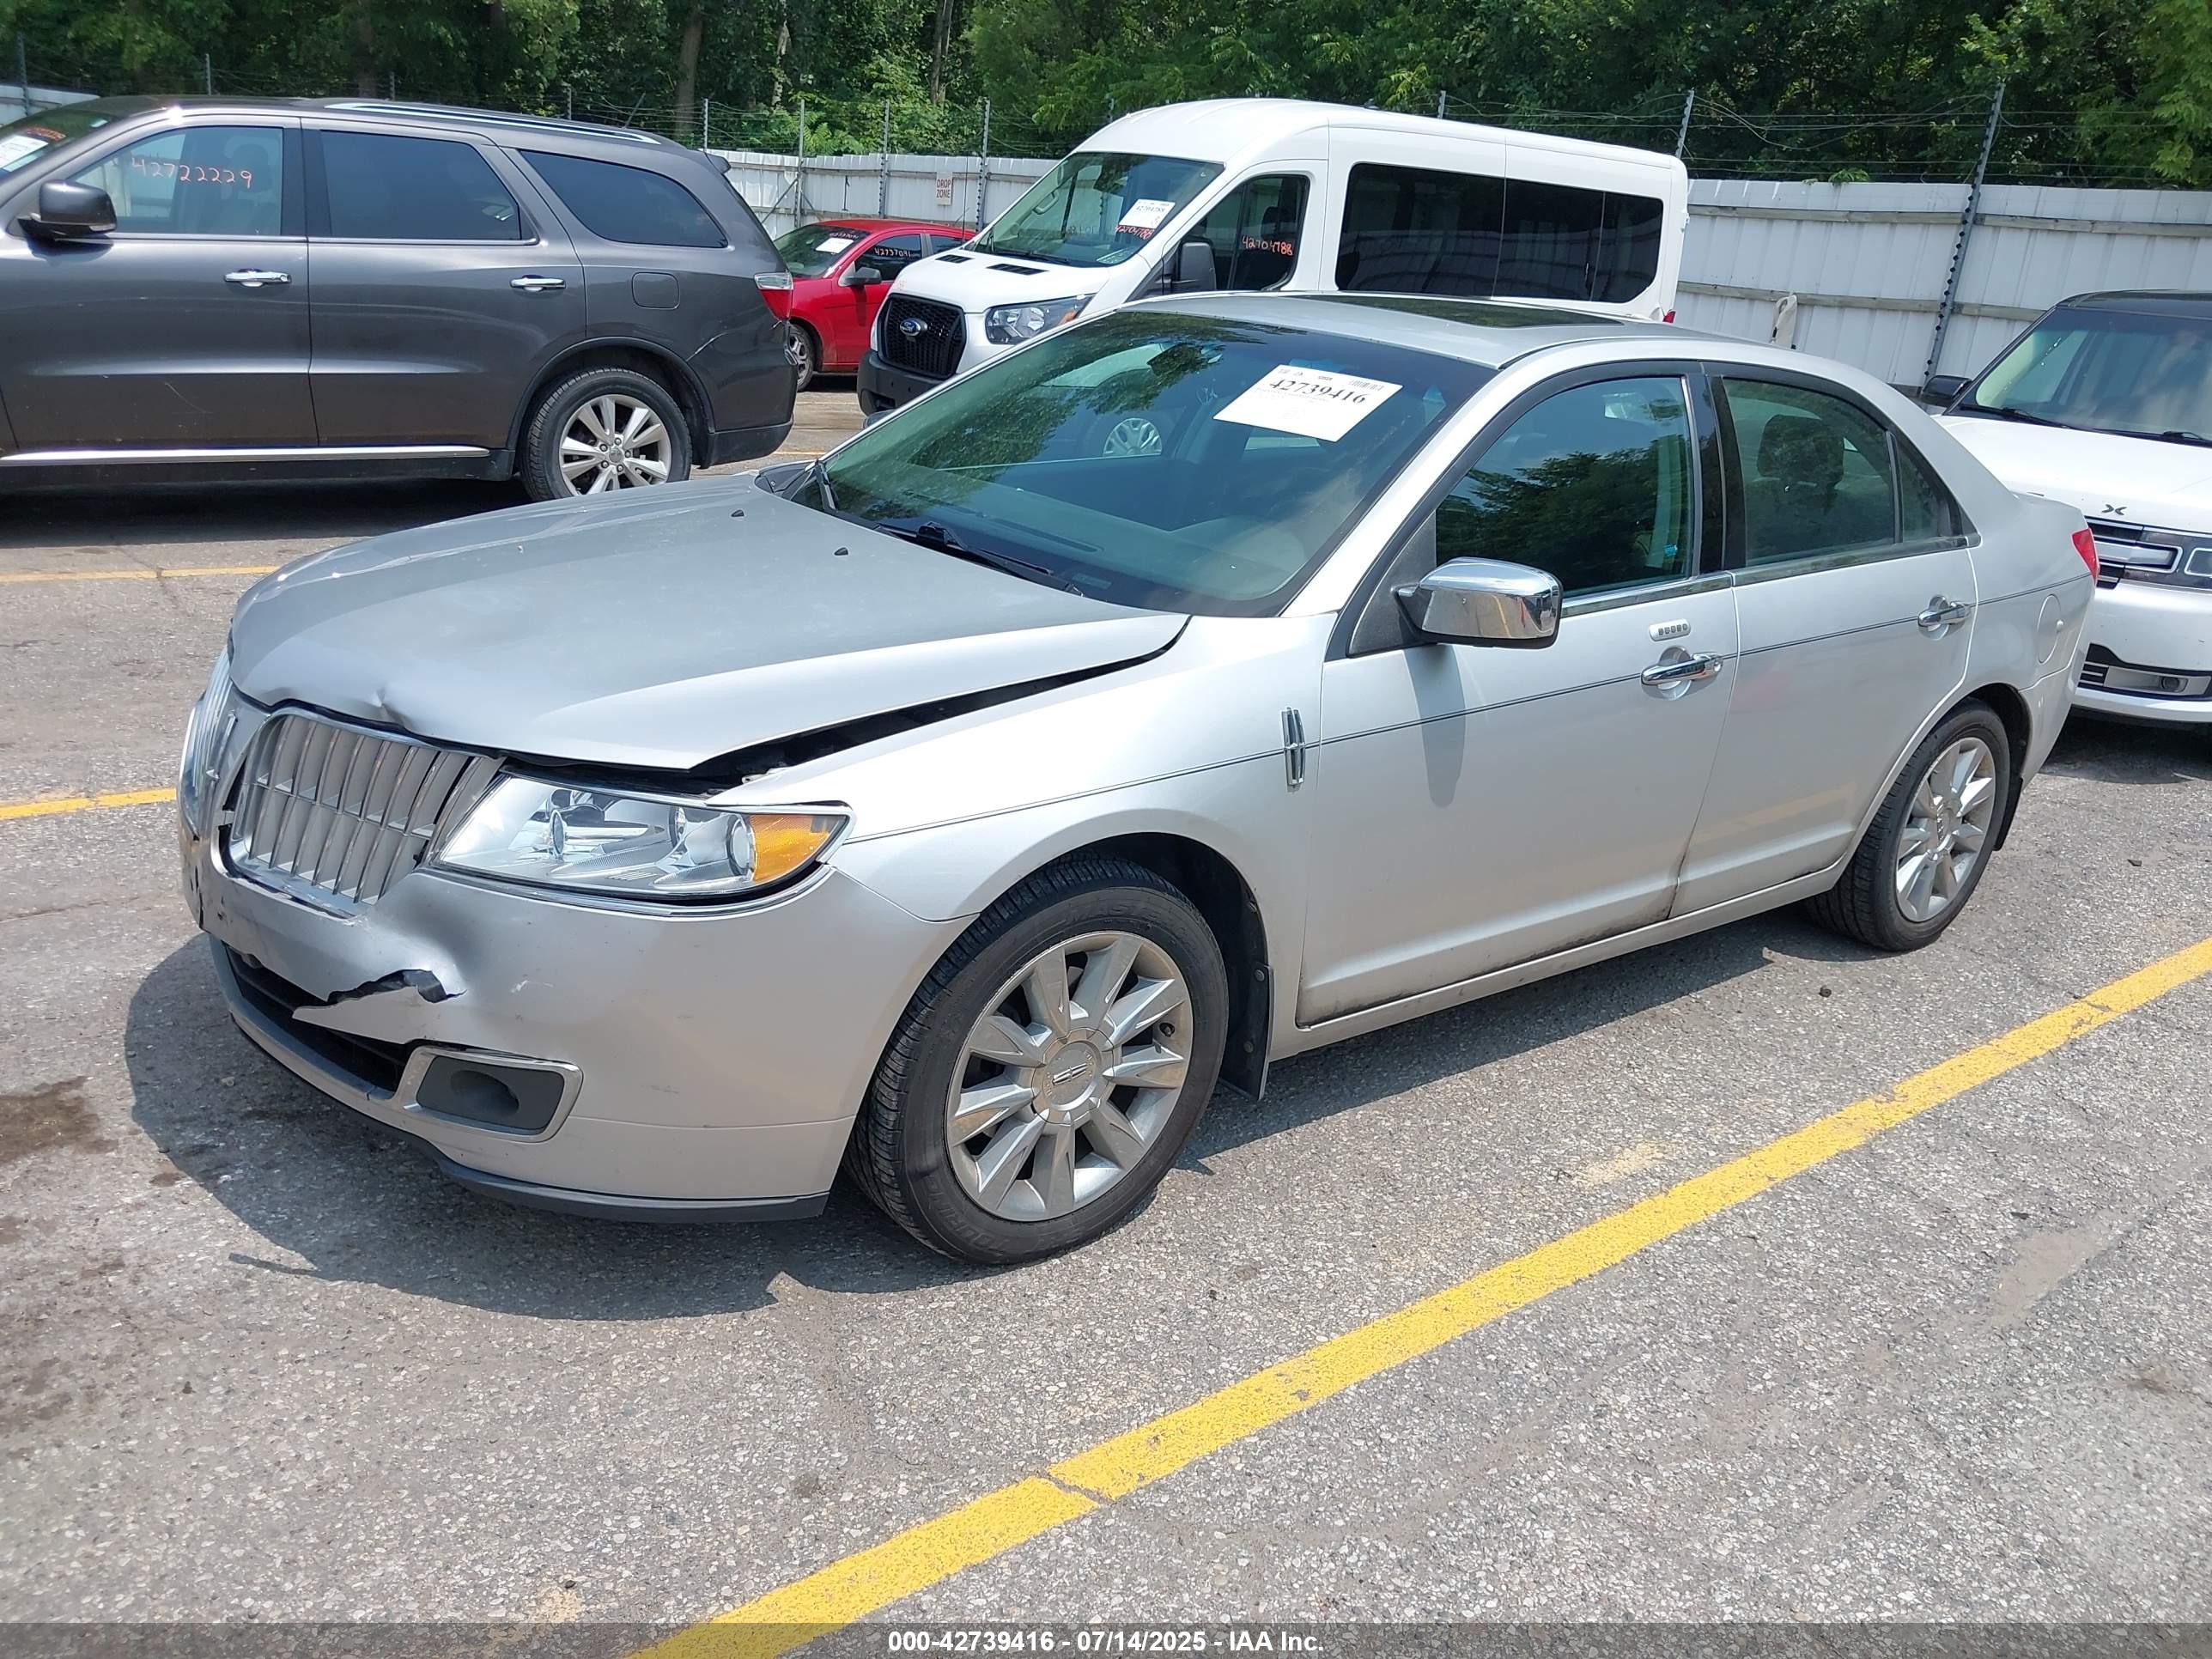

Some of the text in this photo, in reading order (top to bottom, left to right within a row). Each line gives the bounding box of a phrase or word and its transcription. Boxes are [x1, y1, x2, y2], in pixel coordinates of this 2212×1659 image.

[131, 157, 252, 189] 42722229
[936, 179, 951, 188] DROP
[936, 189, 951, 198] ZONE
[1242, 235, 1294, 256] 42704788
[1269, 379, 1367, 404] 42739416
